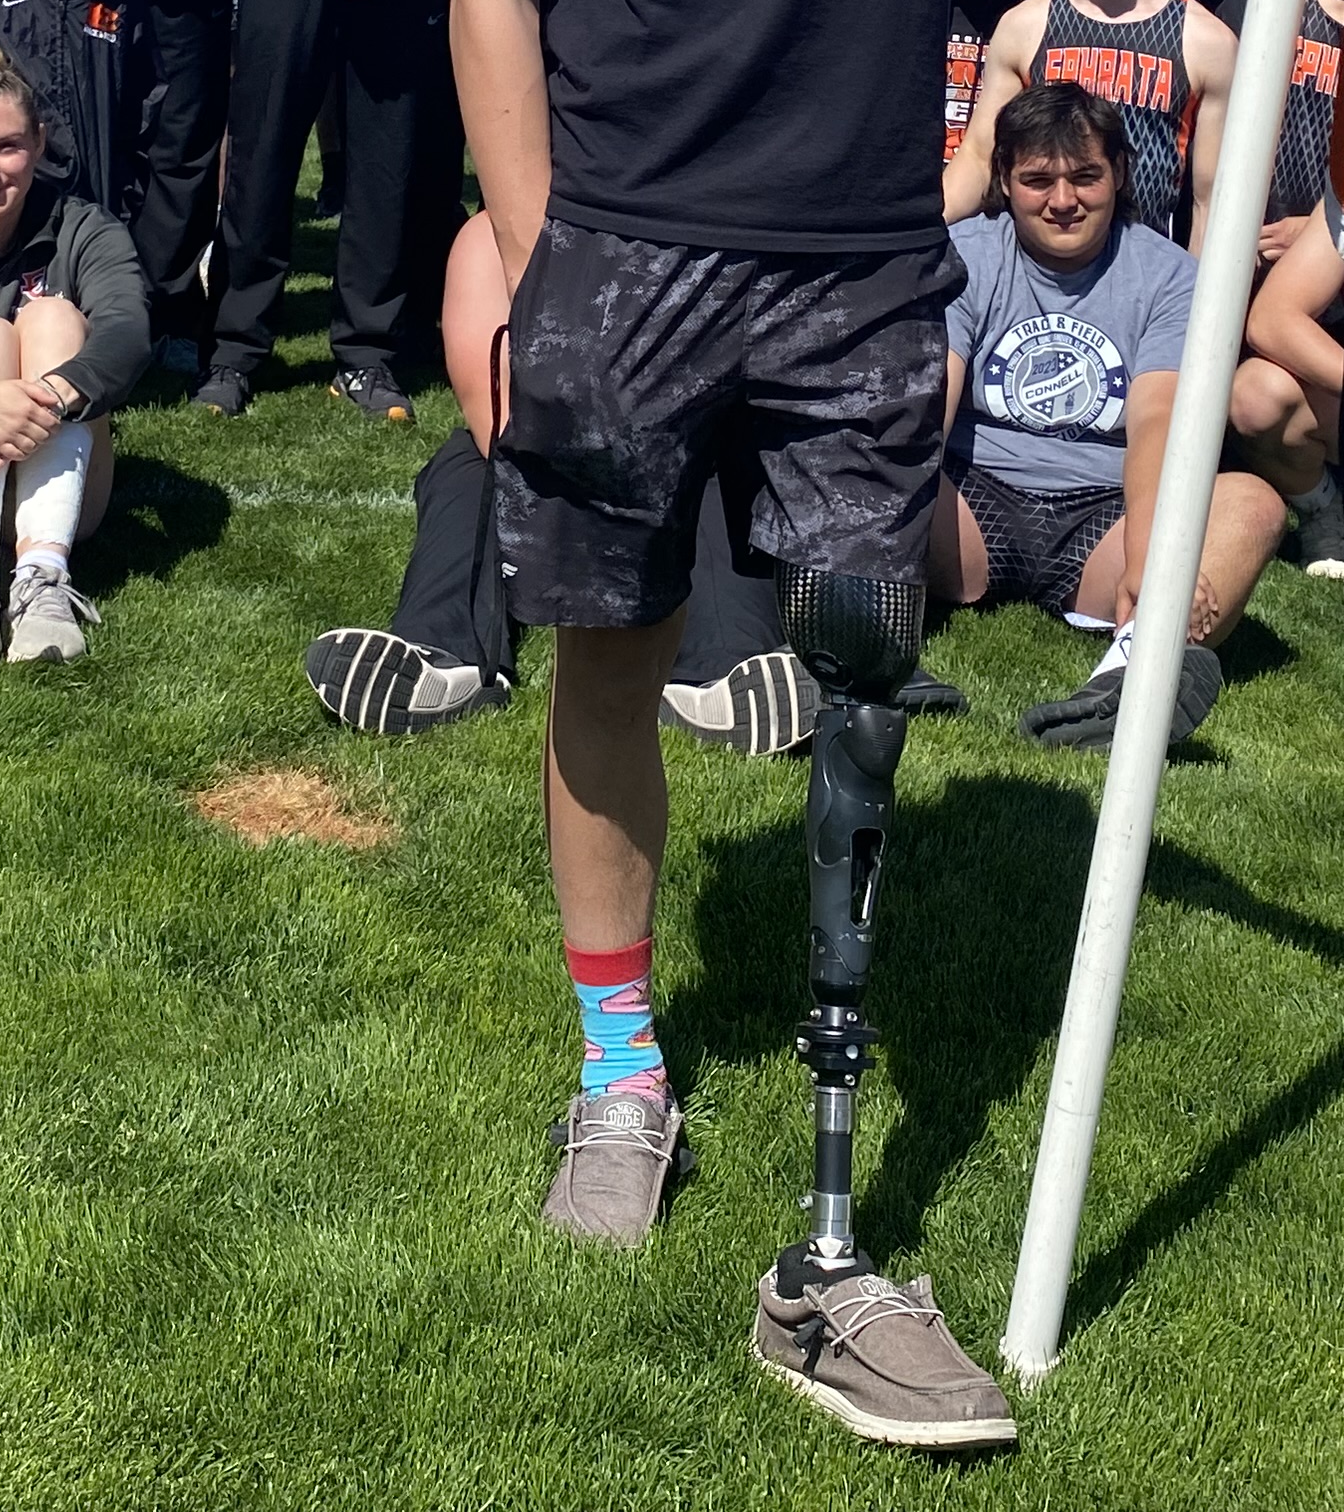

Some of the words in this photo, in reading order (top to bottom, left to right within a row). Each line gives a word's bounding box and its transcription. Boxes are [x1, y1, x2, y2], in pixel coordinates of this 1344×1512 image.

[1057, 317, 1066, 329] &
[1071, 321, 1106, 350] FIELD
[1025, 369, 1083, 400] CONNELL
[608, 1109, 641, 1127] DUDE
